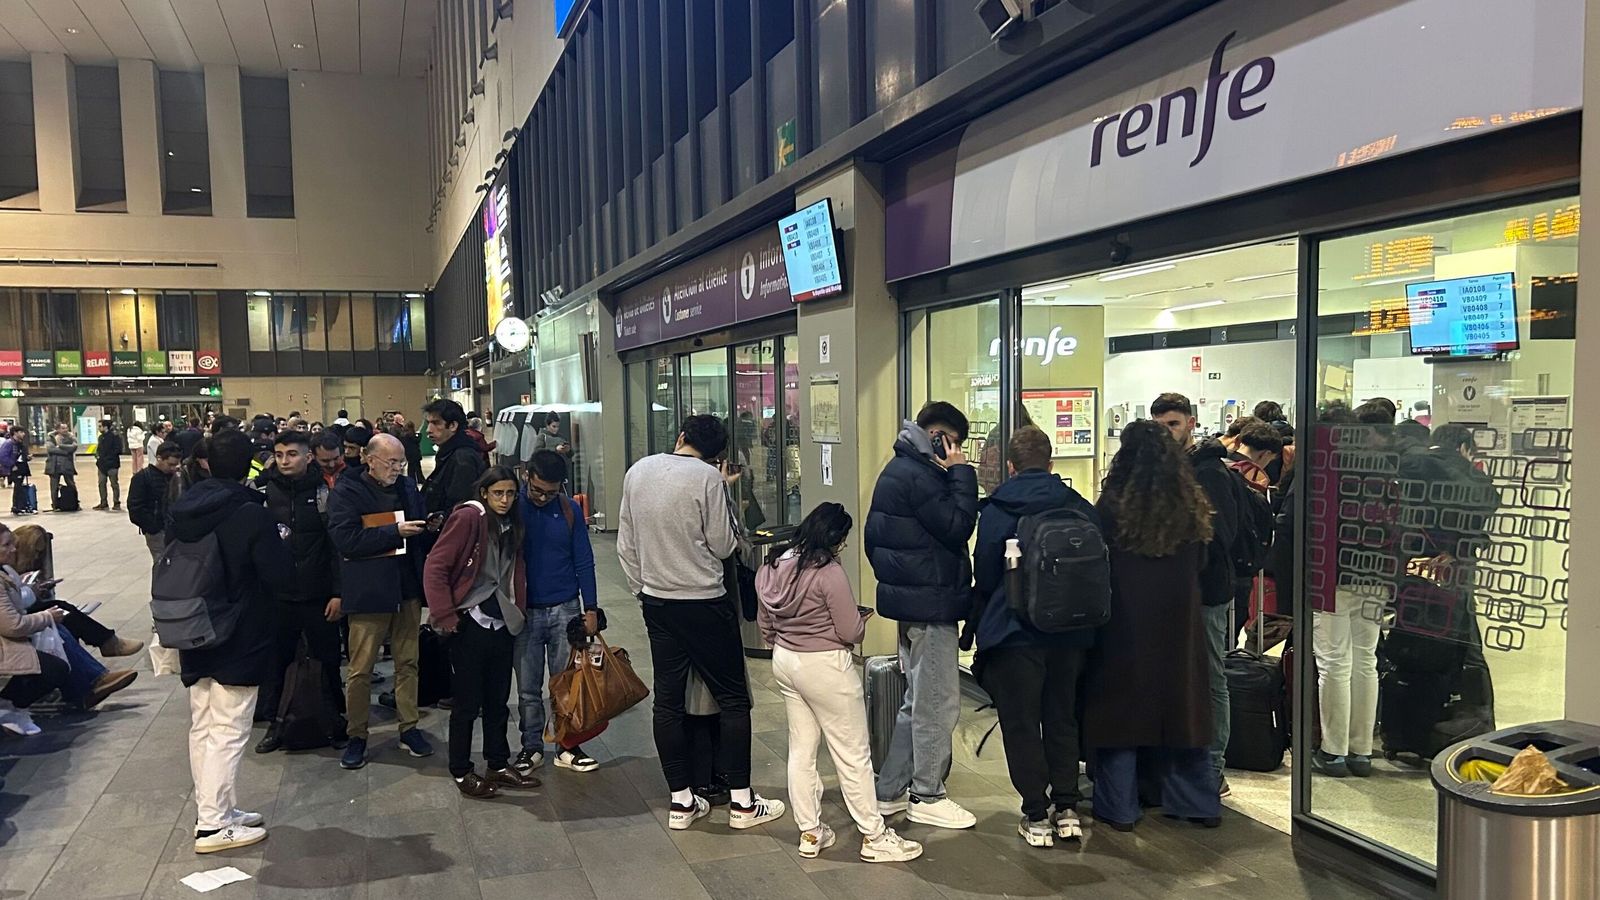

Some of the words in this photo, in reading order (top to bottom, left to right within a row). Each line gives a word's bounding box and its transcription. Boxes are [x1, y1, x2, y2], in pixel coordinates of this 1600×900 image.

[1090, 30, 1275, 168] renfe
[706, 266, 728, 290] cliente
[1221, 330, 1227, 342] 3
[1290, 325, 1296, 336] 4
[989, 326, 1077, 366] rnfe
[1112, 342, 1116, 352] 1
[1162, 336, 1167, 348] 2
[1241, 401, 1246, 410] 3
[1396, 400, 1402, 410] 5
